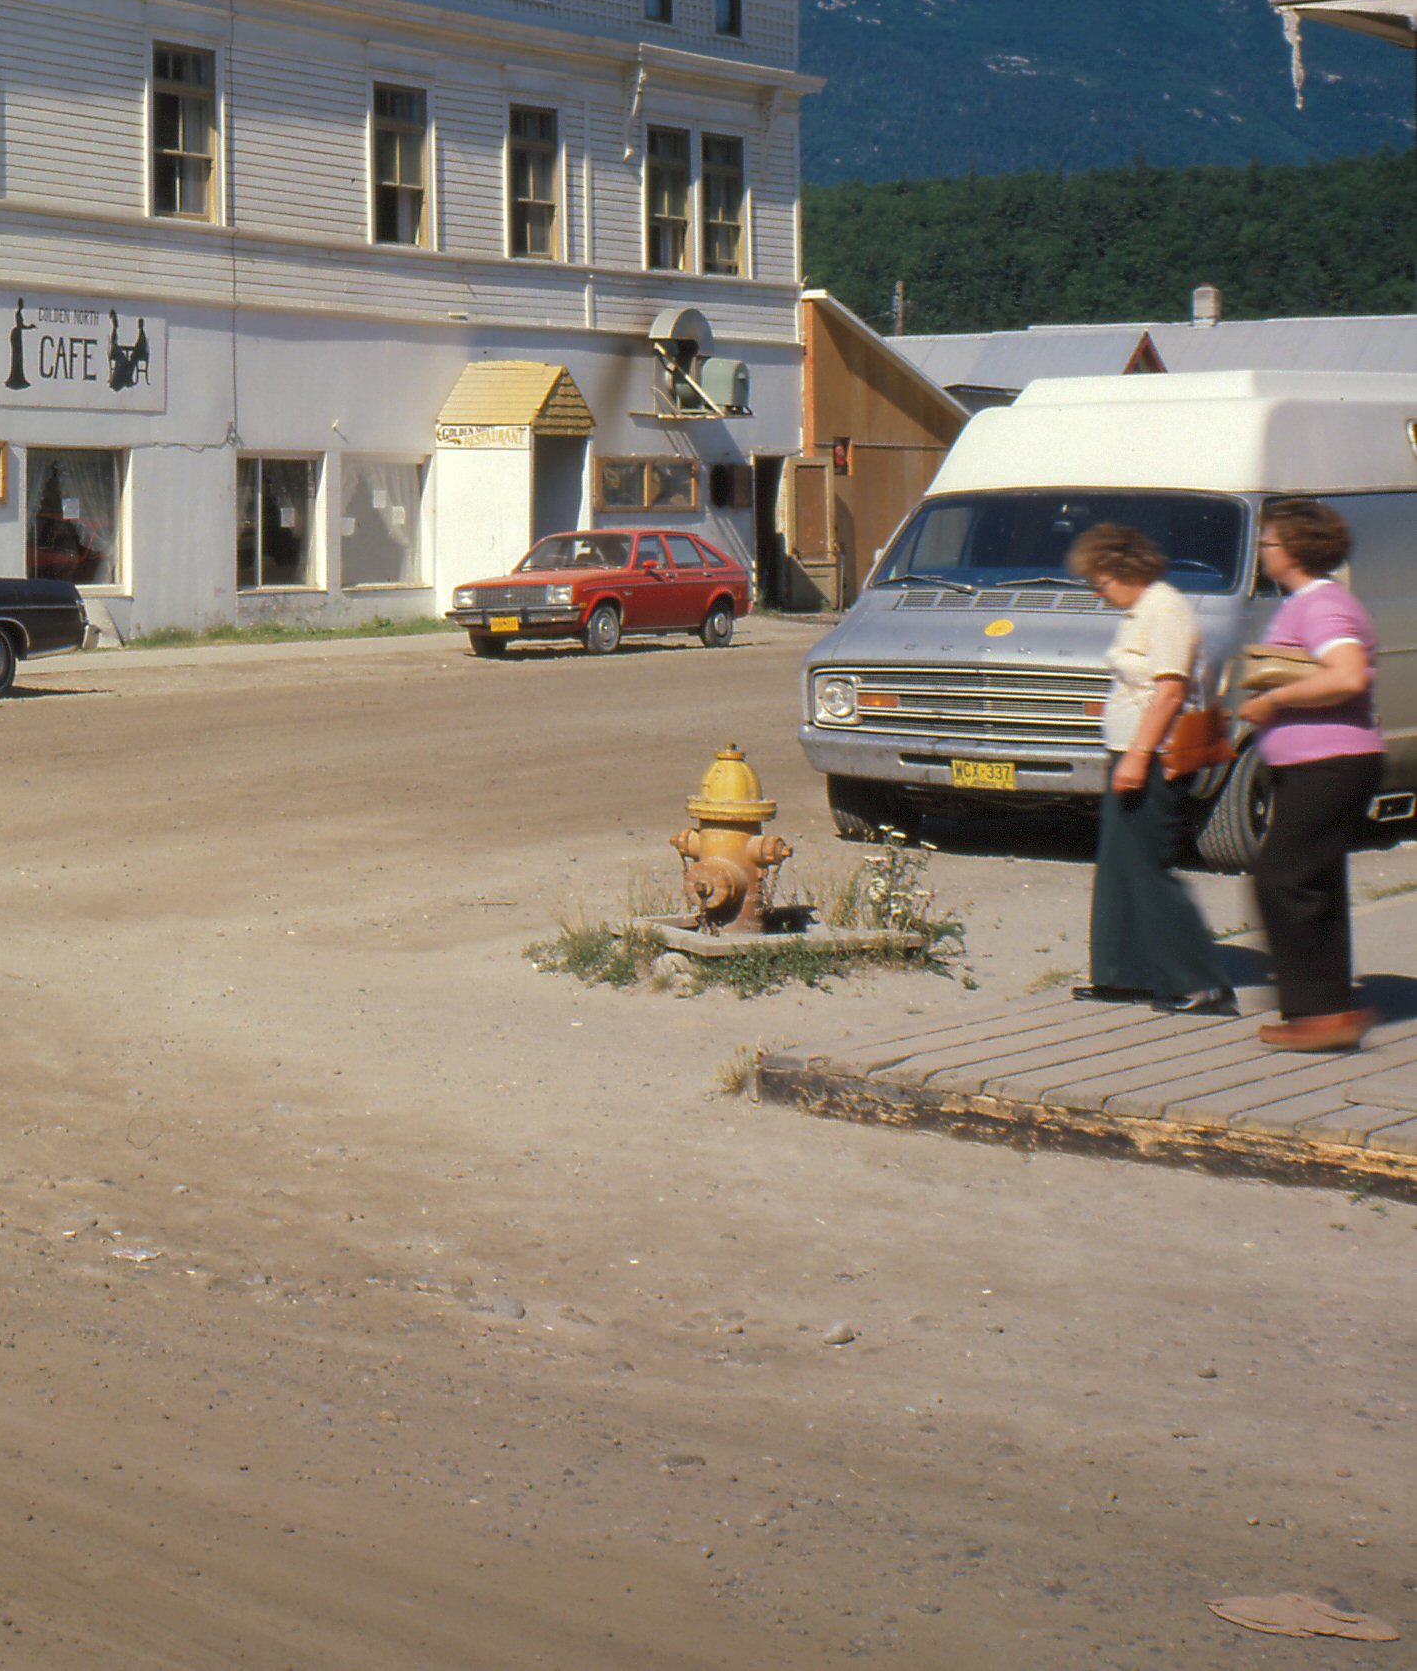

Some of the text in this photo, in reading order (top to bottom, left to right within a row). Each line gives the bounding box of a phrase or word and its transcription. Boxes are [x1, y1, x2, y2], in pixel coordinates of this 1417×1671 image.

[38, 306, 100, 326] GOLDEN NORTH
[39, 335, 98, 381] CAFE
